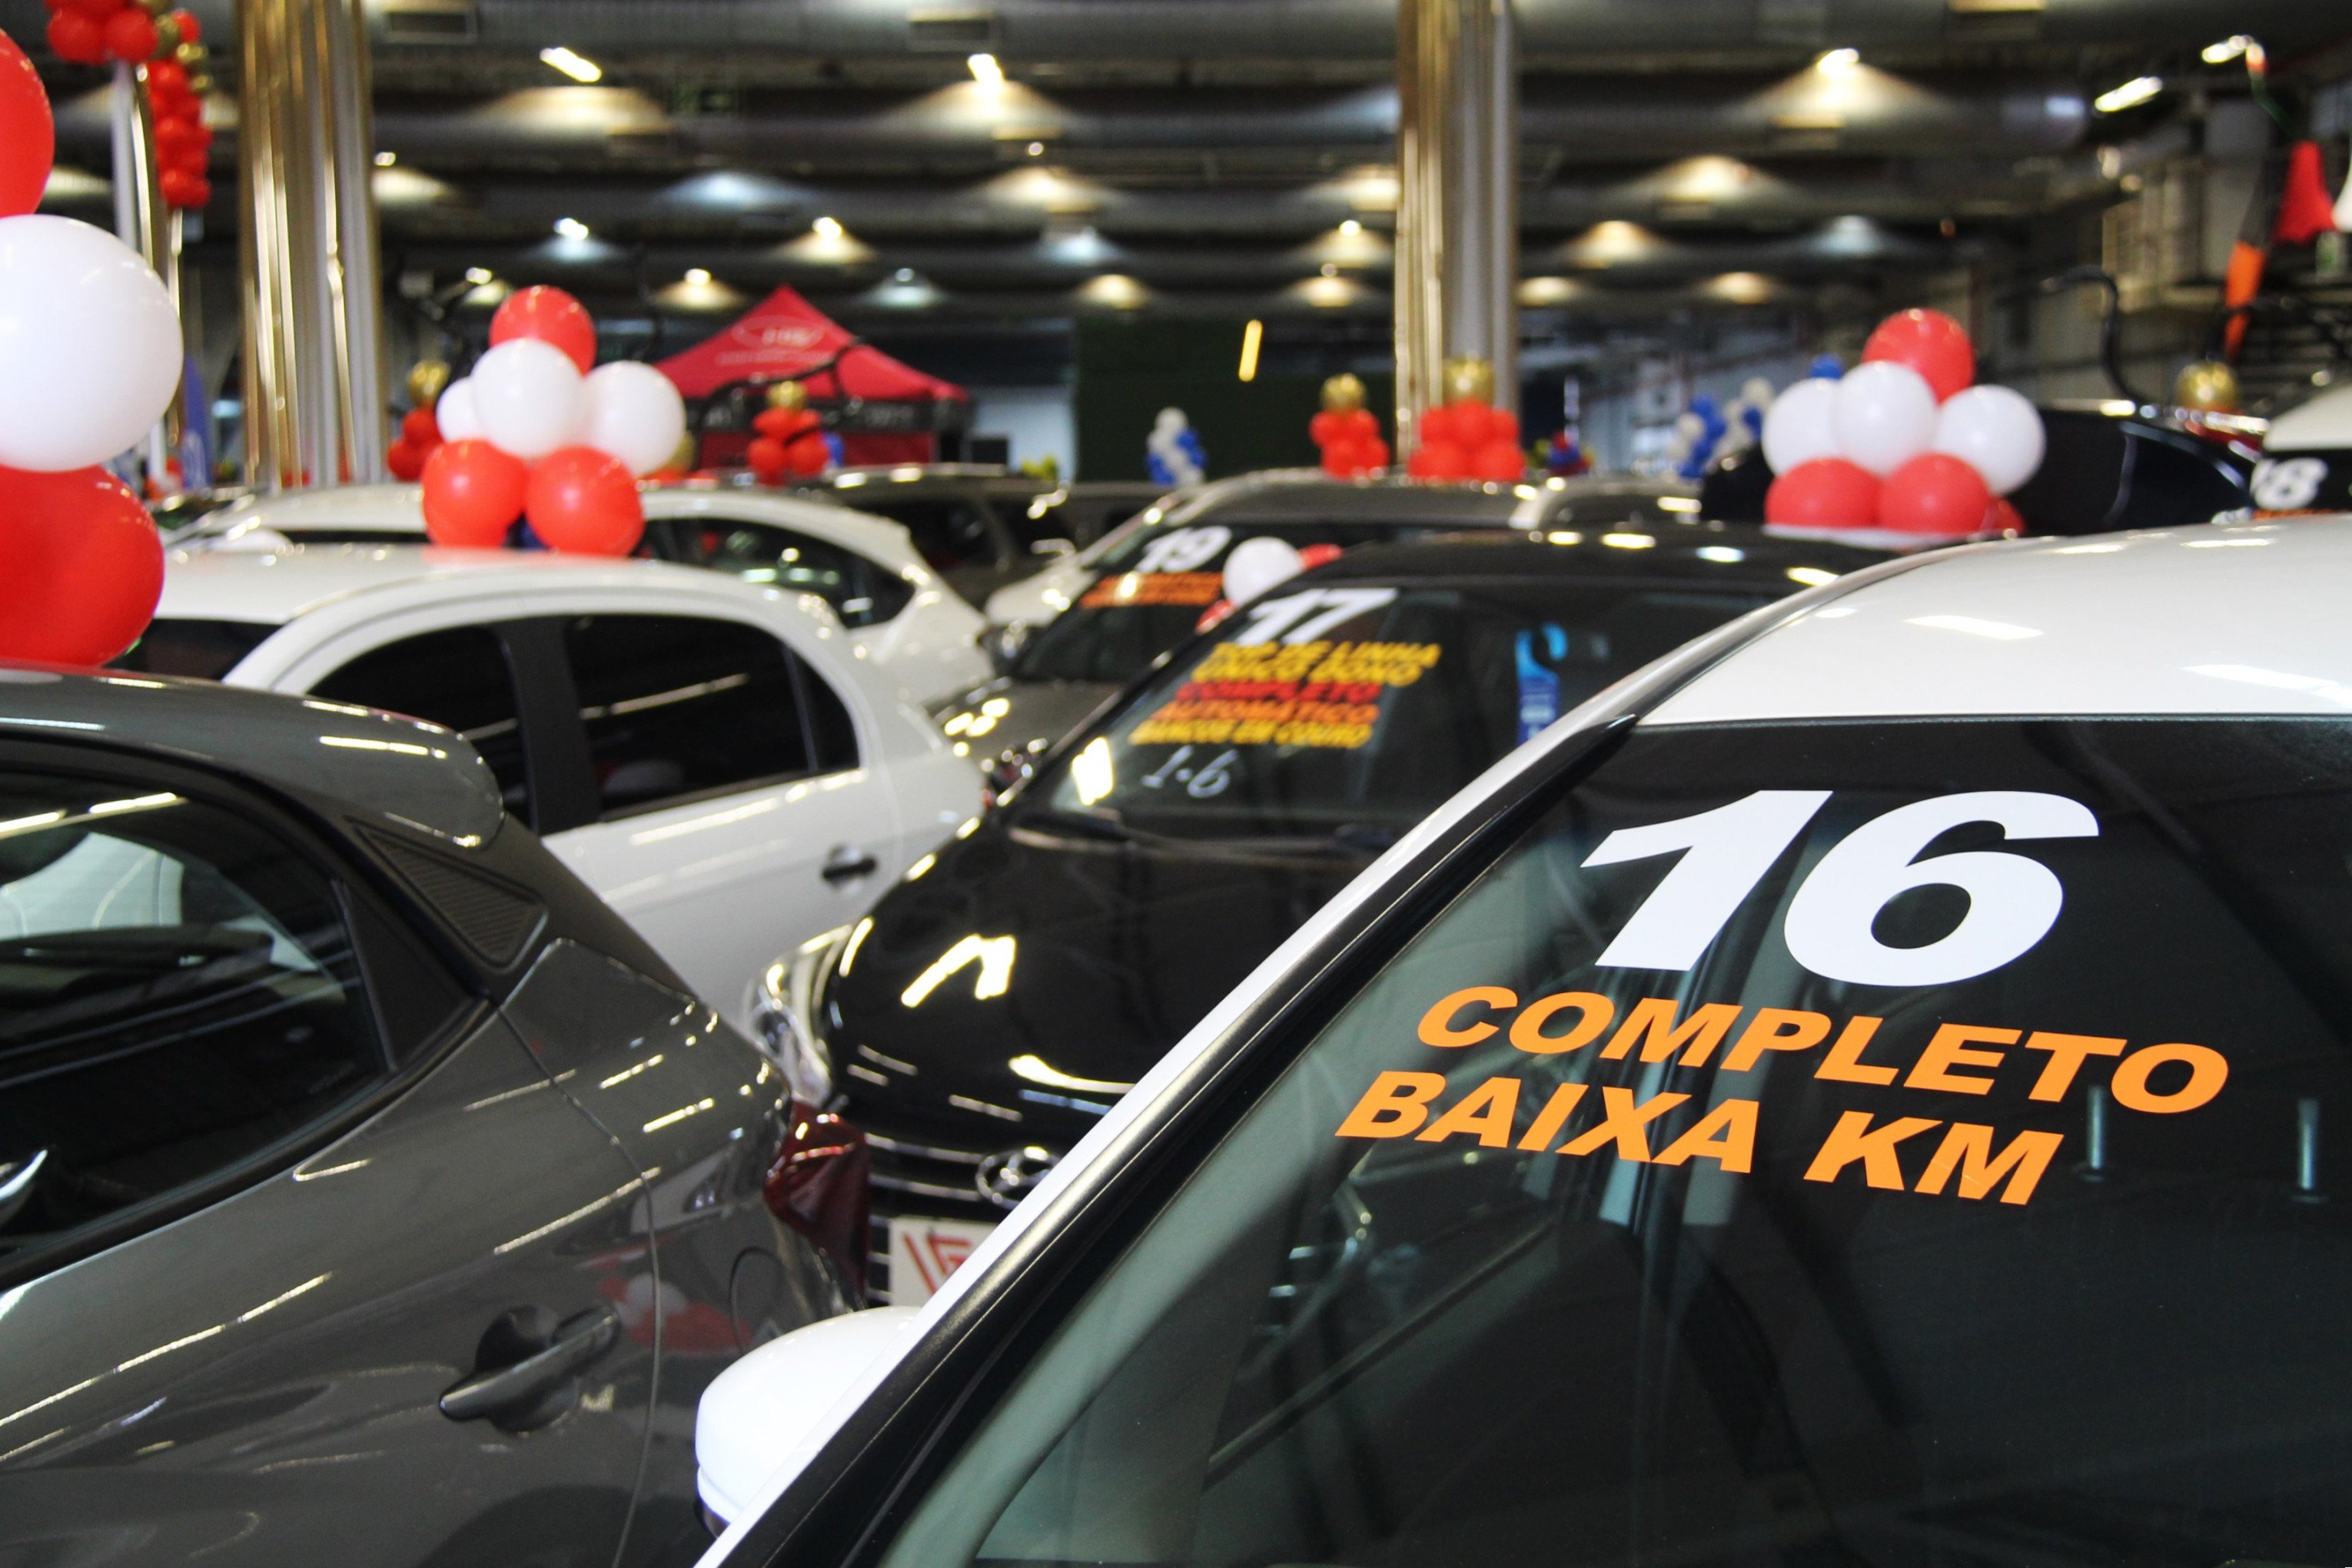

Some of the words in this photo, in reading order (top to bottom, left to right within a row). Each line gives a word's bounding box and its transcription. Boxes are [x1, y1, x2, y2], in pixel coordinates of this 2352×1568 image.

[1134, 527, 1232, 573] 19
[1234, 587, 1399, 646] 17
[1580, 789, 2100, 988] 16
[1416, 985, 2230, 1115] COMPLETO
[1334, 1070, 1760, 1174] BAIXA
[1803, 1111, 2065, 1206] KM
